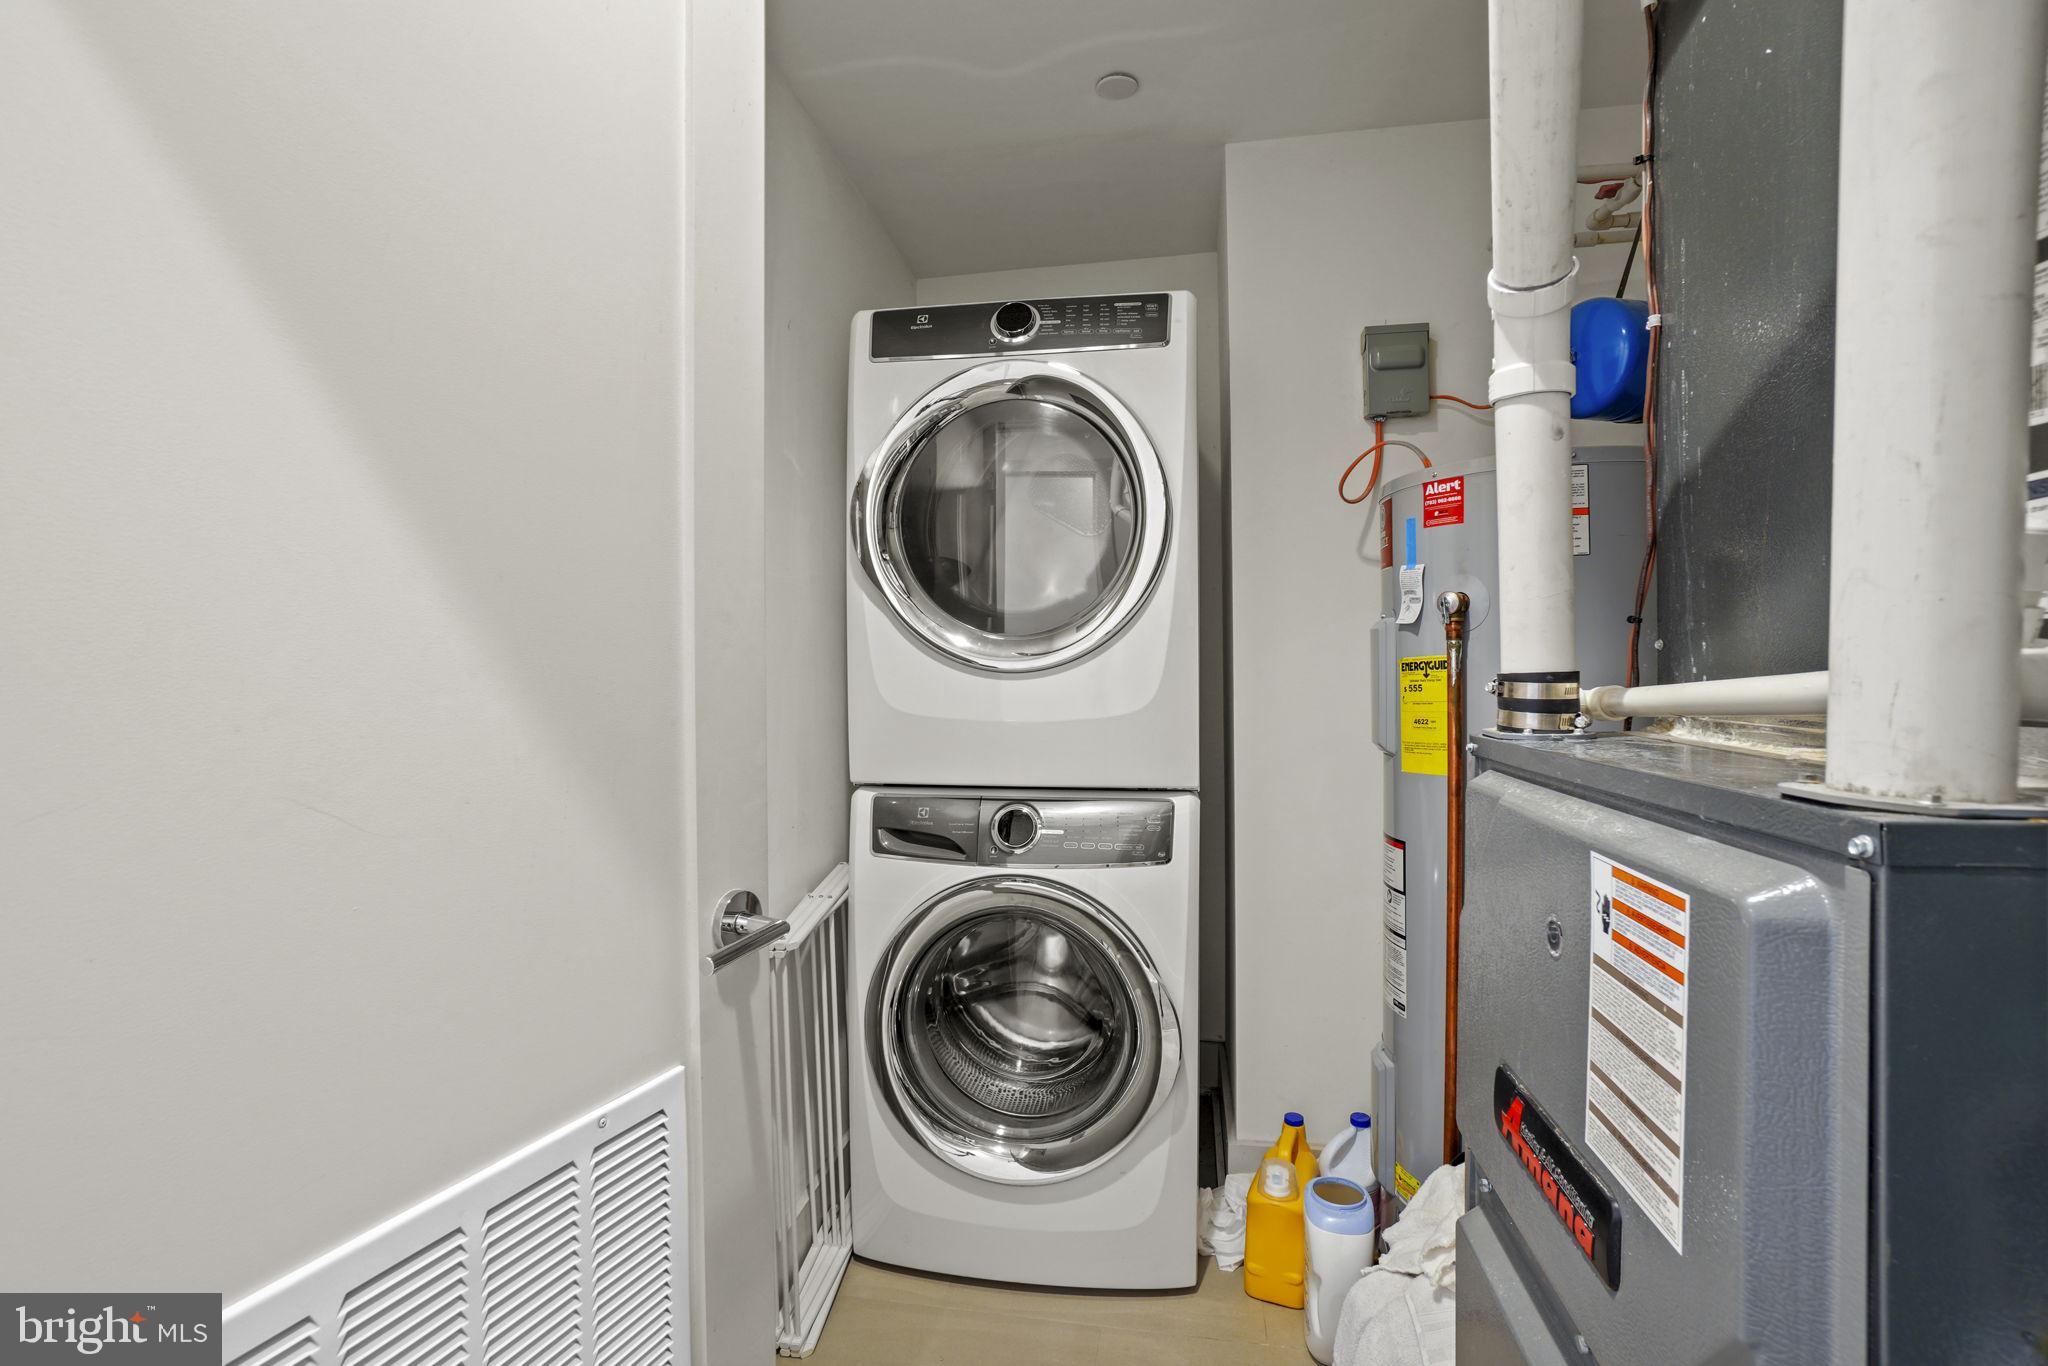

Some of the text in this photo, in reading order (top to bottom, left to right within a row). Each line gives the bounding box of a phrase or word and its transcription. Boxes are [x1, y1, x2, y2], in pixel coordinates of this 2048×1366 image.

[1425, 479, 1461, 496] Alert
[1401, 660, 1448, 671] ENERGYGUID
[1408, 684, 1423, 692] 555
[1501, 1096, 1594, 1260] Amana
[1554, 1168, 1594, 1229] Conditioning
